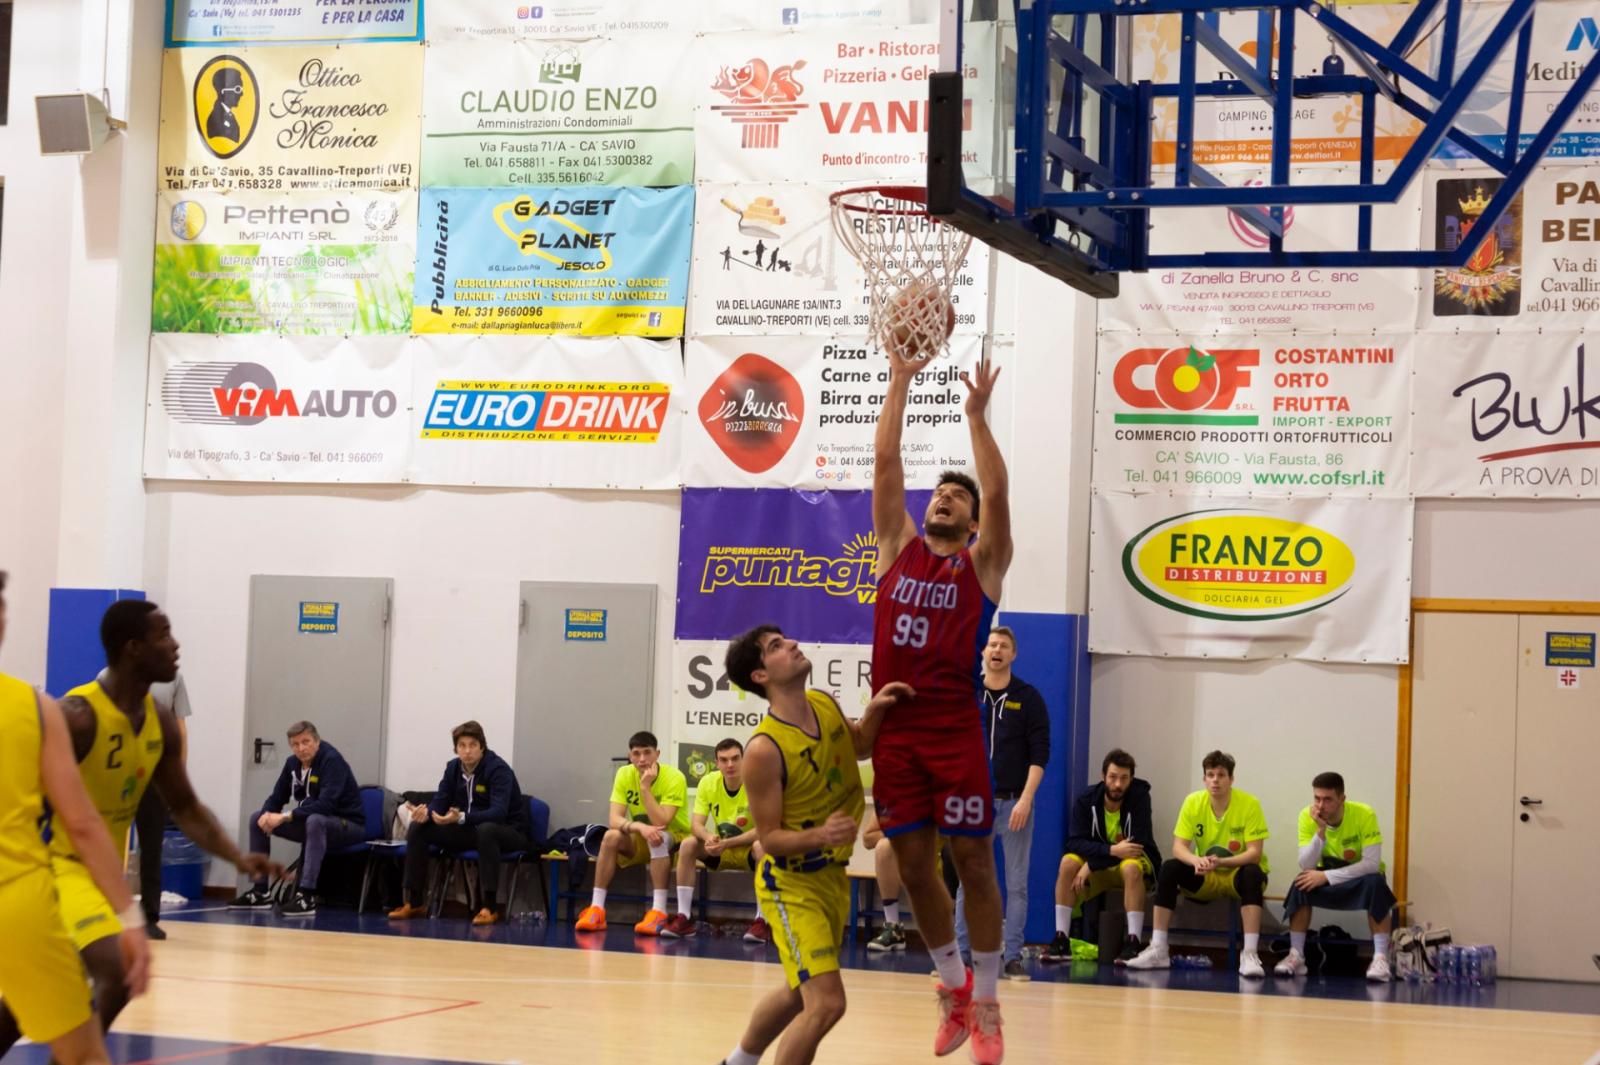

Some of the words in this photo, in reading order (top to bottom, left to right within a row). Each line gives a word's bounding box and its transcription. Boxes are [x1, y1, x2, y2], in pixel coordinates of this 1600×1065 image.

[322, 12, 330, 24] E
[332, 11, 355, 24] PER
[357, 10, 371, 23] LA
[375, 9, 404, 22] CASA
[837, 43, 865, 58] Bar
[299, 58, 362, 88] Ottico
[823, 67, 887, 83] Pizzeria
[269, 89, 389, 120] Francesco
[460, 89, 575, 113] CLAUDIO
[586, 86, 658, 112] ENZO
[477, 118, 561, 129] Amministrazioni
[563, 114, 634, 128] Condominiali
[1218, 109, 1268, 123] CAMPING
[276, 120, 378, 150] Monica
[479, 142, 497, 152] Via
[501, 141, 538, 152] Fausta
[541, 140, 566, 152] 71/A
[602, 139, 636, 150] SAVIO
[464, 157, 482, 168] Tel.
[485, 157, 546, 168] 041.658811
[558, 156, 580, 167] Fax
[583, 155, 653, 168] 041.5300382
[822, 154, 853, 166] Punto
[855, 152, 910, 166] d'incontro
[165, 166, 185, 177] Via
[189, 166, 200, 177] di
[258, 166, 274, 177] 35
[278, 164, 384, 178] Cavallino-Treporti
[387, 163, 412, 176] (VE)
[508, 172, 533, 184] Cell.
[537, 171, 605, 184] 335.5616042
[223, 201, 350, 225] Pettenò
[238, 231, 304, 241] IMPIANTI
[308, 231, 337, 241] SRL
[219, 256, 270, 268] IMPIANTI
[271, 255, 349, 268] TECNOLOGICI
[556, 260, 606, 271] JESOLO
[1553, 257, 1578, 273] Via
[1582, 257, 1597, 273] di
[454, 279, 532, 289] ABBIGLIAMENTO
[533, 277, 617, 288] PERSONALIZZATO
[626, 277, 669, 288] GADGET
[1160, 269, 1175, 285] di
[1180, 269, 1234, 285] Zanella
[1239, 269, 1285, 284] Bruno
[1290, 269, 1301, 283] &
[1308, 269, 1325, 283] C.
[1330, 272, 1359, 283] snc
[454, 291, 496, 302] BANNER
[504, 291, 542, 301] ADESIVI
[592, 290, 606, 300] SU
[1183, 291, 1220, 300] VENDITA
[1221, 291, 1271, 300] INGROSSO
[1281, 290, 1332, 299] DETTAGLIO
[454, 306, 472, 317] Tel.
[475, 306, 494, 317] 331
[497, 306, 543, 317] 9660096
[716, 300, 731, 310] VIA
[732, 300, 751, 310] DEL
[751, 300, 801, 310] LAGUNARE
[803, 300, 841, 310] 13A/INT.3
[1140, 303, 1155, 311] VIA
[1257, 303, 1309, 312] CAVALLINO
[1311, 303, 1356, 311] TREPORTI
[452, 321, 479, 331] e-mail:
[716, 315, 812, 326] CAVALLINO-TREPORTI
[814, 315, 831, 328] (VE)
[833, 314, 851, 326] cell.
[823, 345, 867, 360] Pizza
[1274, 347, 1394, 364] COSTANTINI
[821, 368, 872, 383] Carne
[1113, 347, 1260, 411] COF
[1273, 372, 1329, 388] ORTO
[460, 382, 652, 392] WWW.EURODRINK.ORG
[301, 389, 397, 418] AUTO
[820, 390, 861, 405] Birra
[1272, 396, 1350, 412] FRUTTA
[428, 392, 537, 428] EURO
[542, 394, 665, 429] DRINK
[906, 410, 962, 428] propria
[1272, 416, 1324, 427] IMPORT
[1337, 416, 1393, 427] EXPORT
[441, 431, 556, 441] DISTRIBUZIONE
[578, 433, 638, 441] SERVIZI
[1115, 429, 1196, 442] COMMERCIO
[1201, 431, 1269, 443] PRODOTTI
[1273, 431, 1393, 444] ORTOFRUTTICOLI
[168, 449, 182, 460] Via
[184, 449, 196, 460] del
[199, 450, 243, 464] Tipografo,
[243, 452, 250, 461] 3
[259, 451, 274, 462] Ca'
[276, 452, 300, 462] Savio
[309, 452, 324, 463] Tel.
[327, 453, 345, 463] 041
[816, 444, 830, 453] Via
[831, 443, 865, 455] Treportina
[910, 444, 934, 453] SAVIO
[840, 456, 855, 466] 041
[904, 456, 938, 467] Facebook:
[940, 457, 948, 466] In
[948, 456, 967, 466] busa
[1155, 451, 1180, 464] CA'
[1184, 451, 1230, 465] SAVIO
[1244, 452, 1264, 465] Via
[1269, 453, 1321, 467] Fausta,
[1325, 453, 1344, 466] 86
[815, 468, 852, 483] Google
[1124, 469, 1148, 483] Tel.
[1153, 470, 1179, 484] 041
[1185, 471, 1242, 484] 966009
[1253, 469, 1386, 487] www.cofsrl.it
[1480, 467, 1493, 485] A
[1502, 467, 1573, 486] PROVA
[1581, 467, 1598, 486] DI
[709, 546, 791, 556] SUPERMERCATI
[1170, 533, 1323, 567] FRANZO
[1169, 568, 1324, 583] DISTRIBUZIONE
[1204, 593, 1260, 604] DOLCIARIA
[1264, 595, 1284, 605] GEL
[892, 613, 930, 649] 99
[106, 733, 123, 769] 2
[800, 747, 819, 773] 7
[626, 789, 640, 806] 22
[943, 795, 985, 826] 99
[1195, 823, 1204, 838] 3
